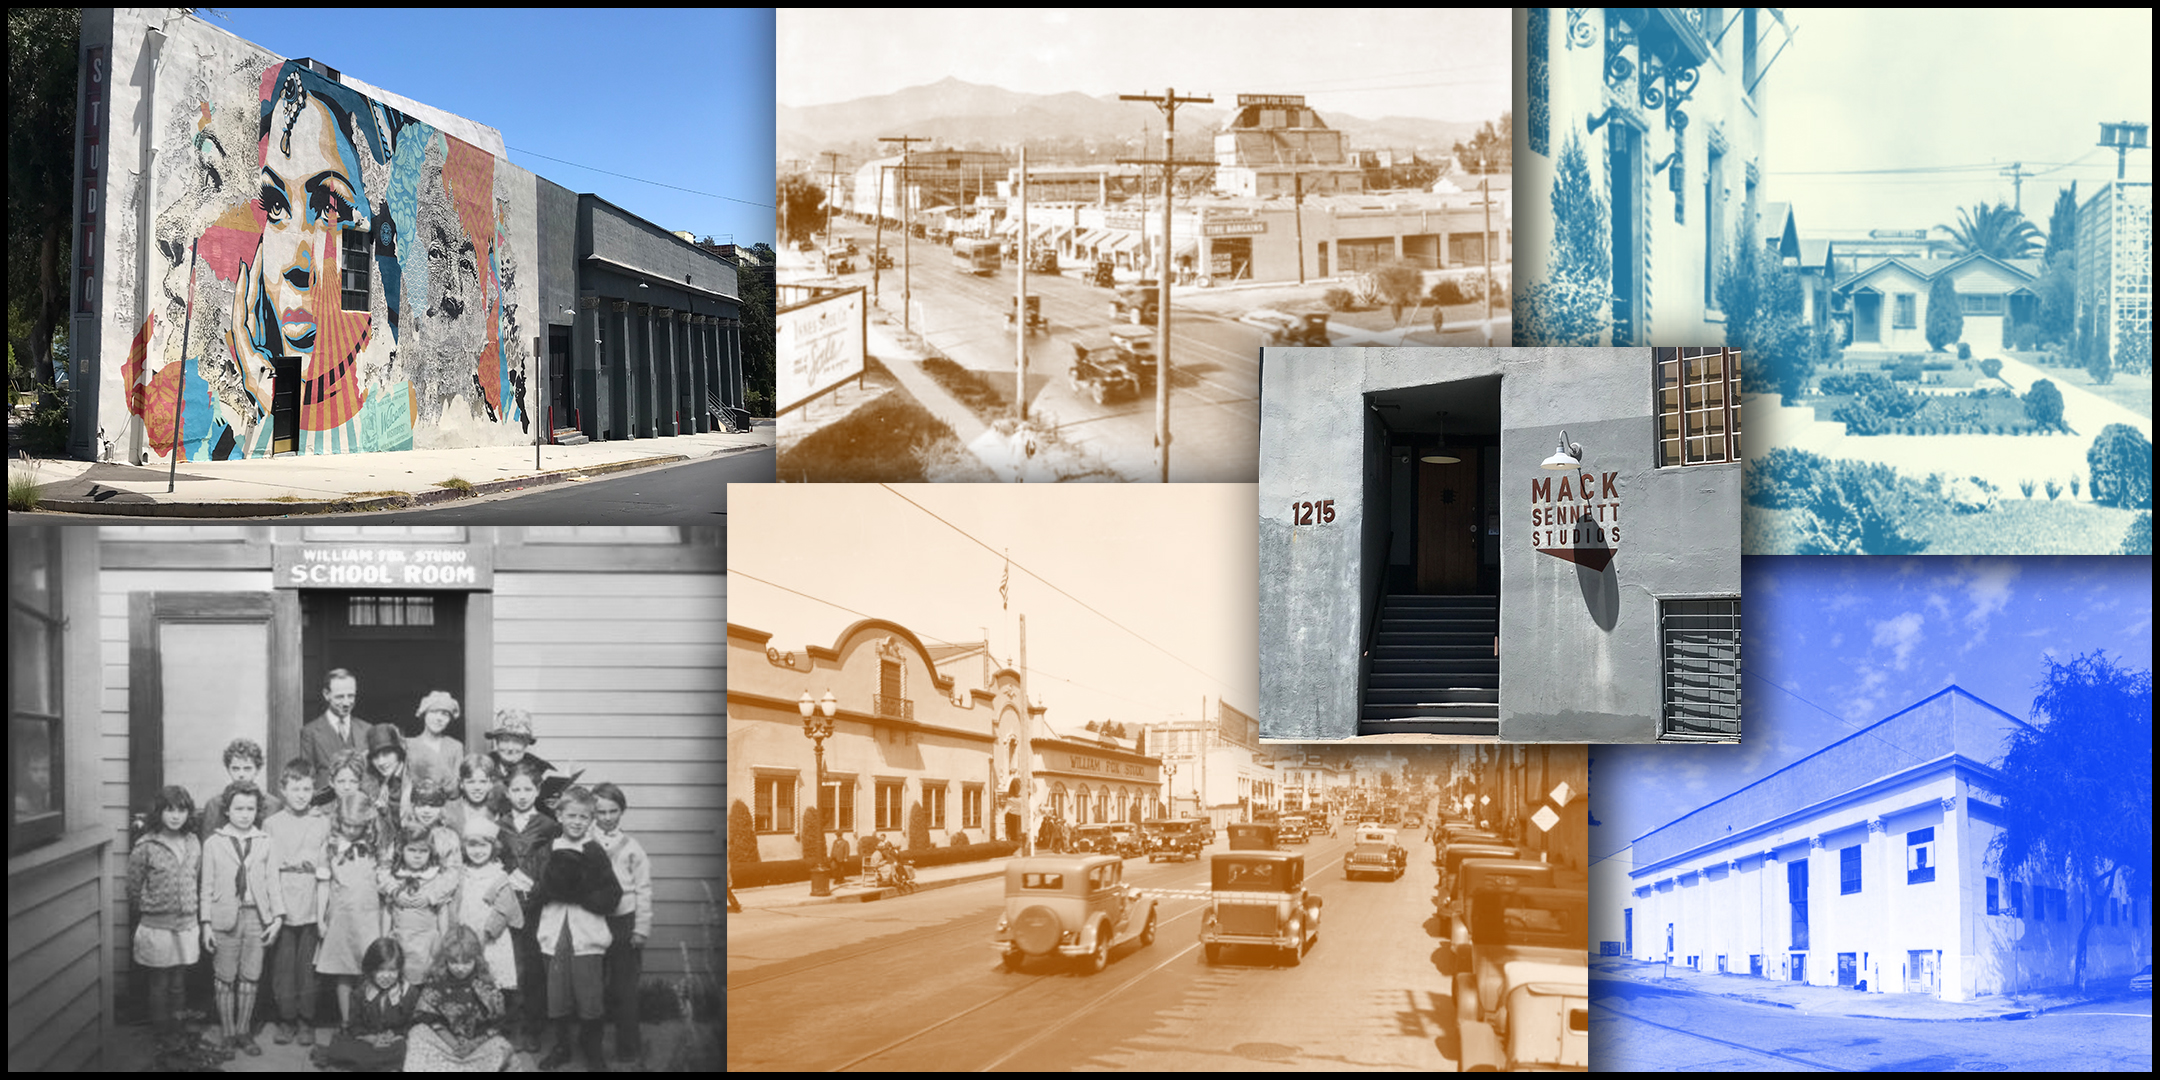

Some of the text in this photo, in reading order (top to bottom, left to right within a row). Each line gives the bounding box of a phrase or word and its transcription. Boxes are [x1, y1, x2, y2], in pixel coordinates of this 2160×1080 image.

[85, 58, 103, 302] STUDIO
[1532, 472, 1619, 504] MACK
[1292, 499, 1336, 526] 1215
[1532, 503, 1620, 527] SENNETT
[1532, 527, 1620, 546] STUDIOS
[303, 549, 468, 563] WILLIAM FOX STUDIO
[290, 564, 476, 584] SCHOOL ROOM
[1070, 755, 1100, 771] WILLIAM
[1106, 760, 1120, 774] FOX
